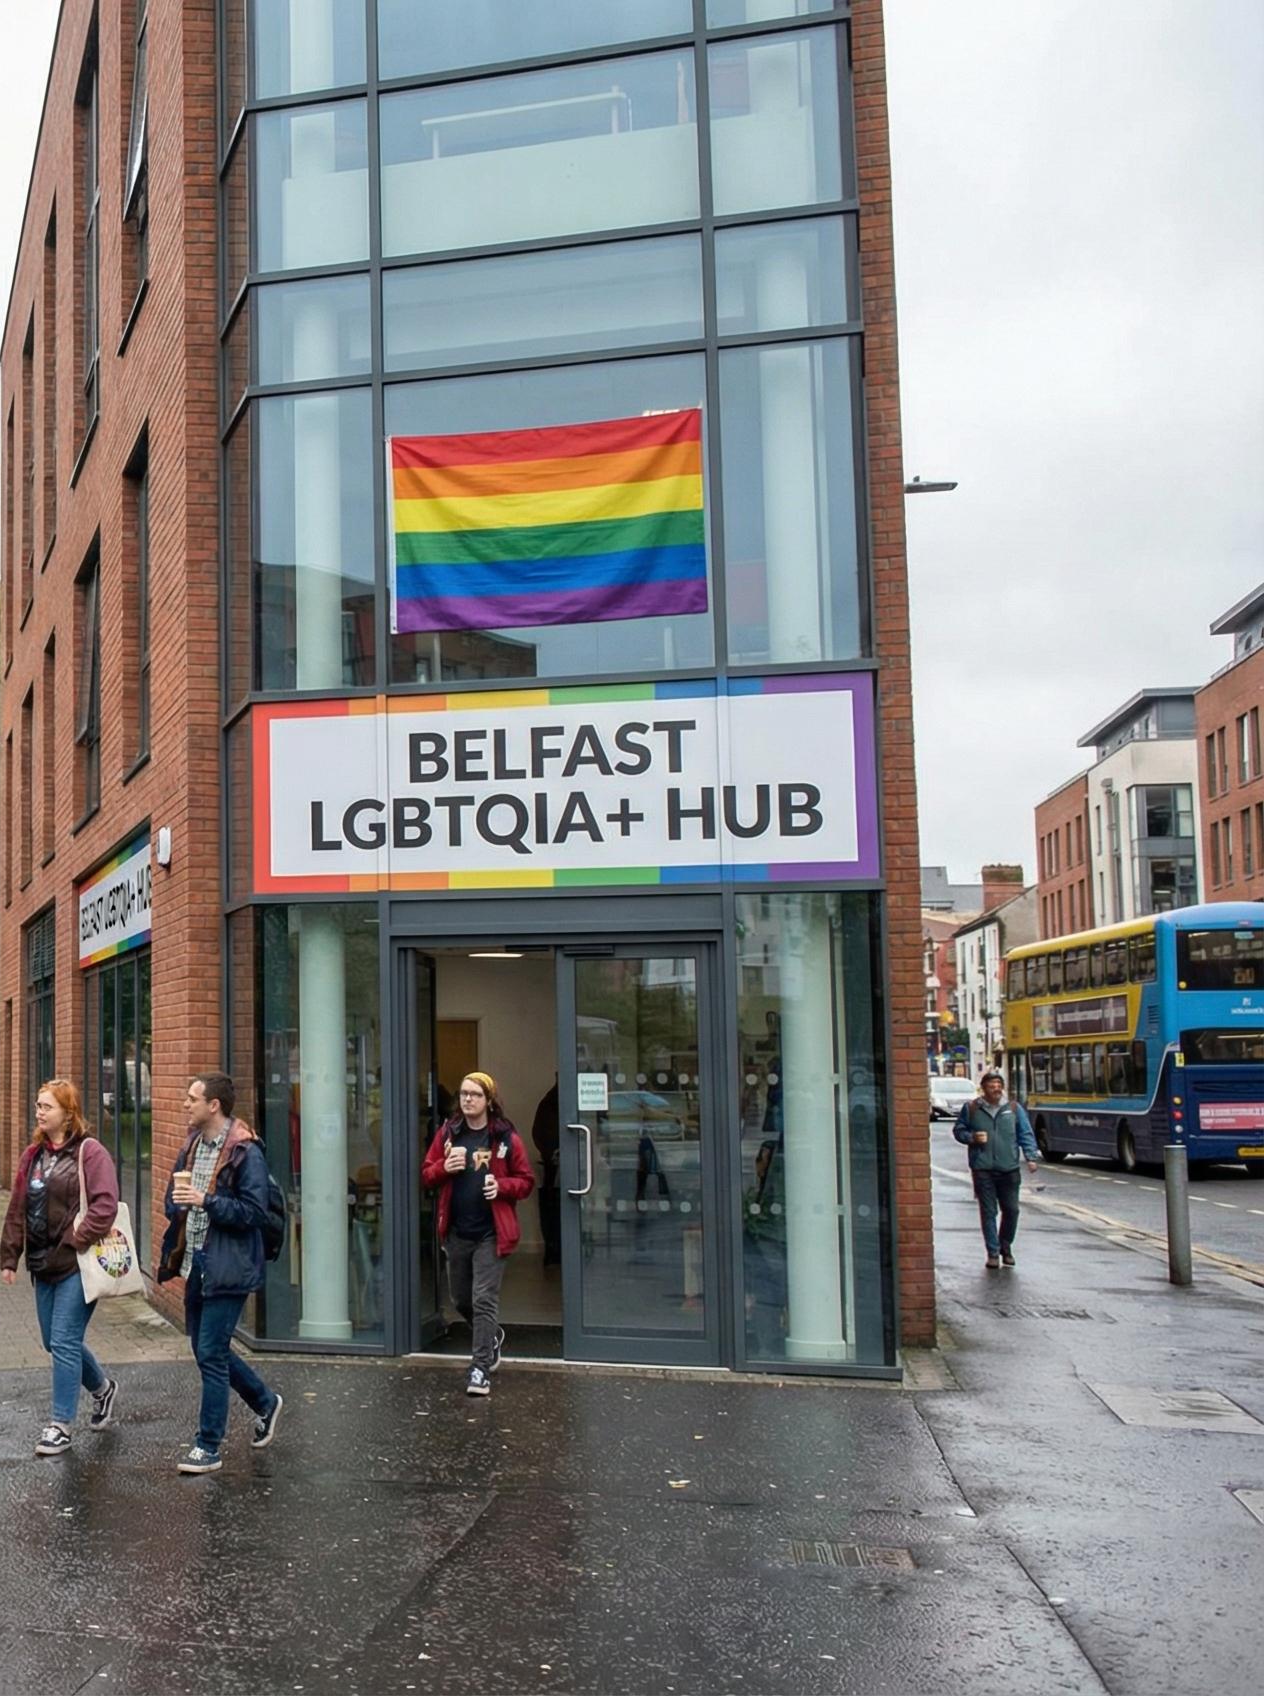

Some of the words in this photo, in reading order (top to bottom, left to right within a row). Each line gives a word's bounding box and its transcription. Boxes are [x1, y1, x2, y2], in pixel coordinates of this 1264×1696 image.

[408, 719, 697, 784] BELFAST
[310, 791, 645, 855] LGBTQIA+
[667, 782, 824, 841] HUB
